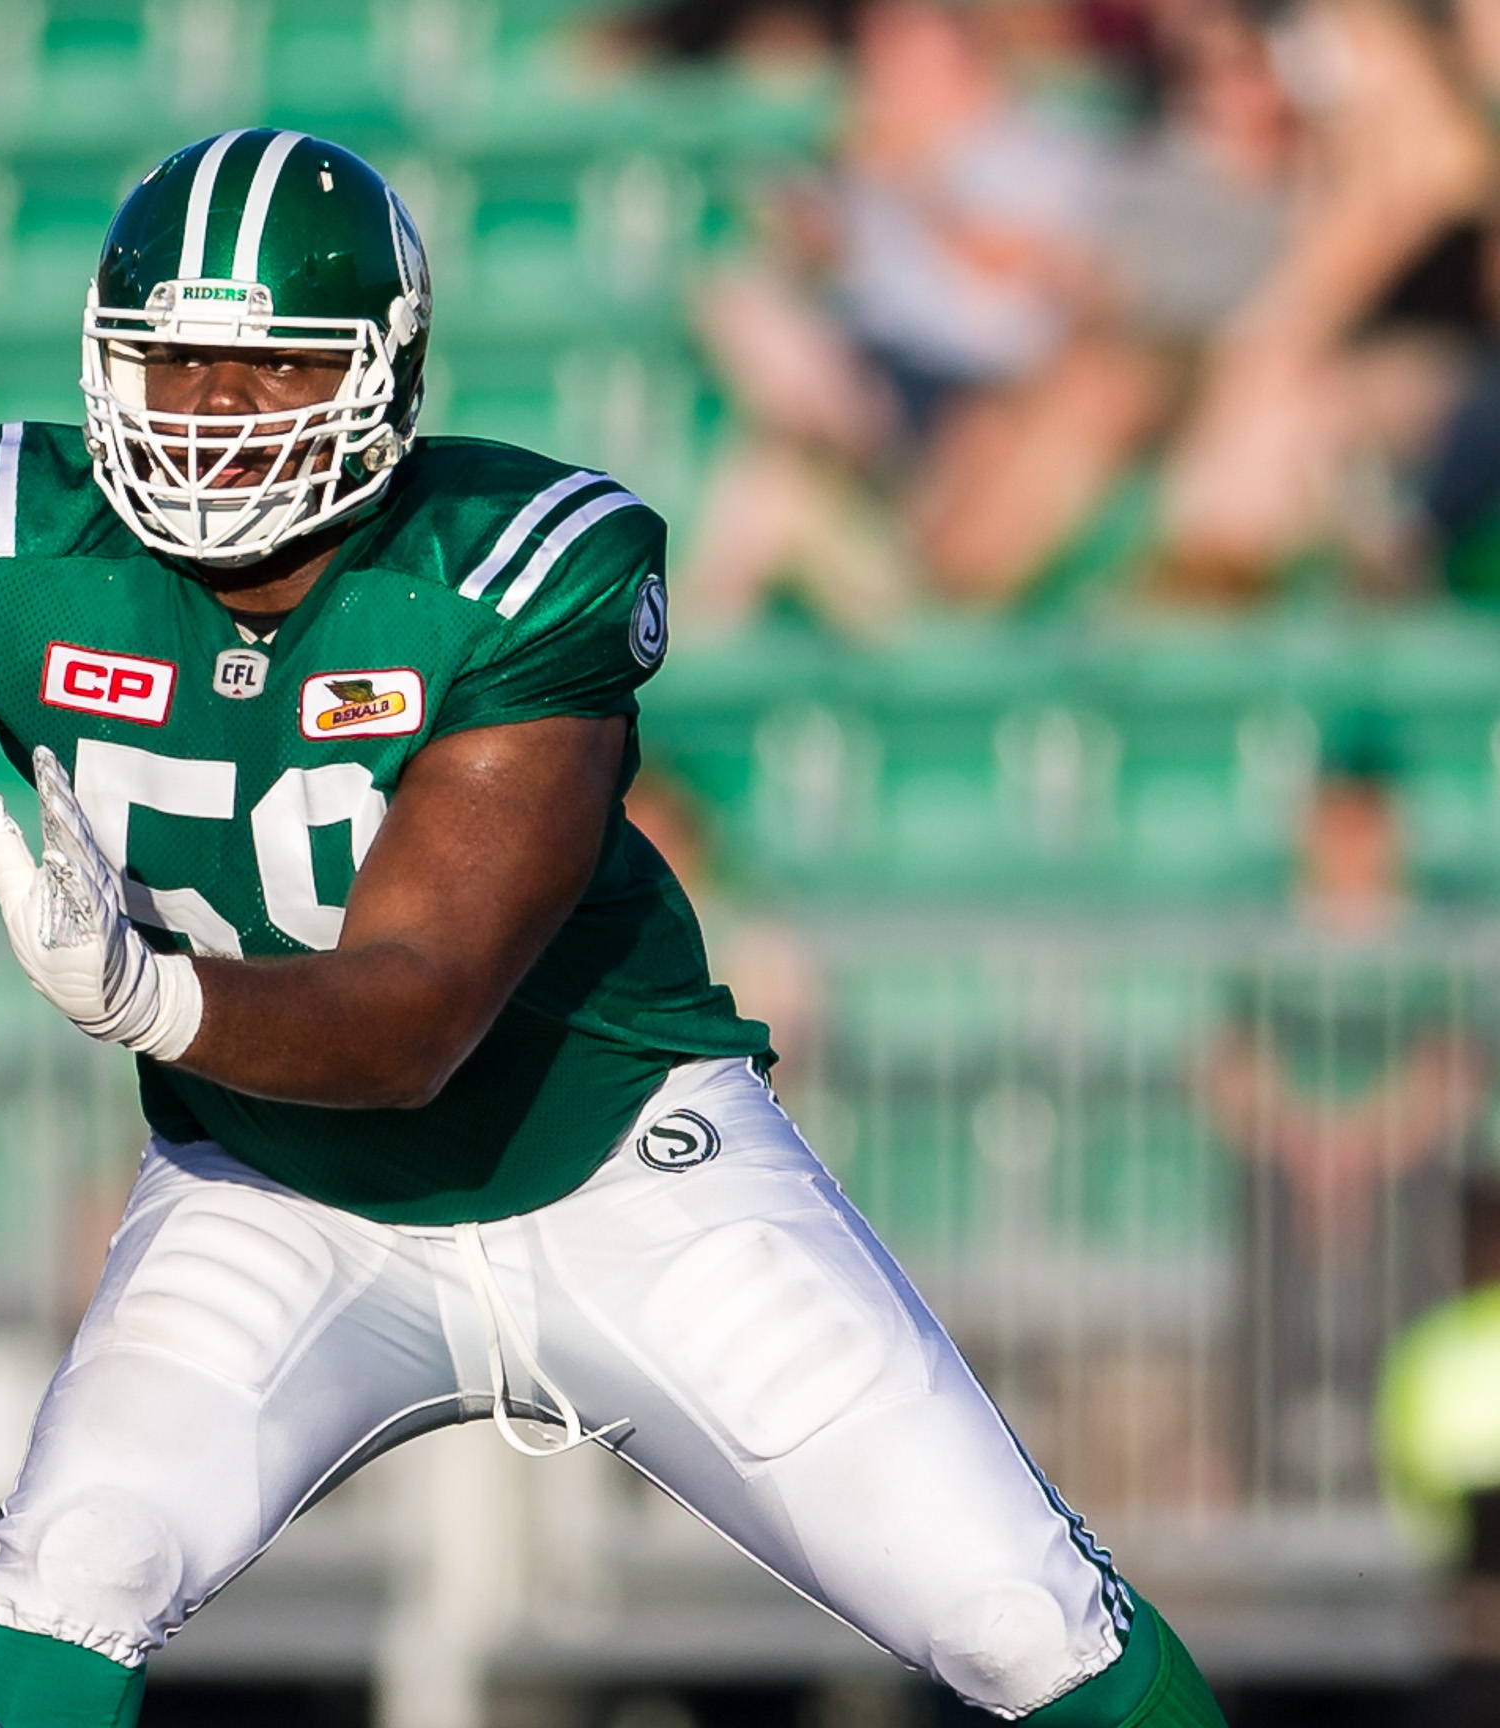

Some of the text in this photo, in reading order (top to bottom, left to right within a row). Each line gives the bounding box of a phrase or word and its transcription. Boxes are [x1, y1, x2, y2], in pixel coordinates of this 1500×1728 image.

[182, 285, 248, 302] RIDERS
[63, 660, 155, 702] CP
[221, 663, 256, 686] CFL
[332, 699, 389, 725] DEKALB
